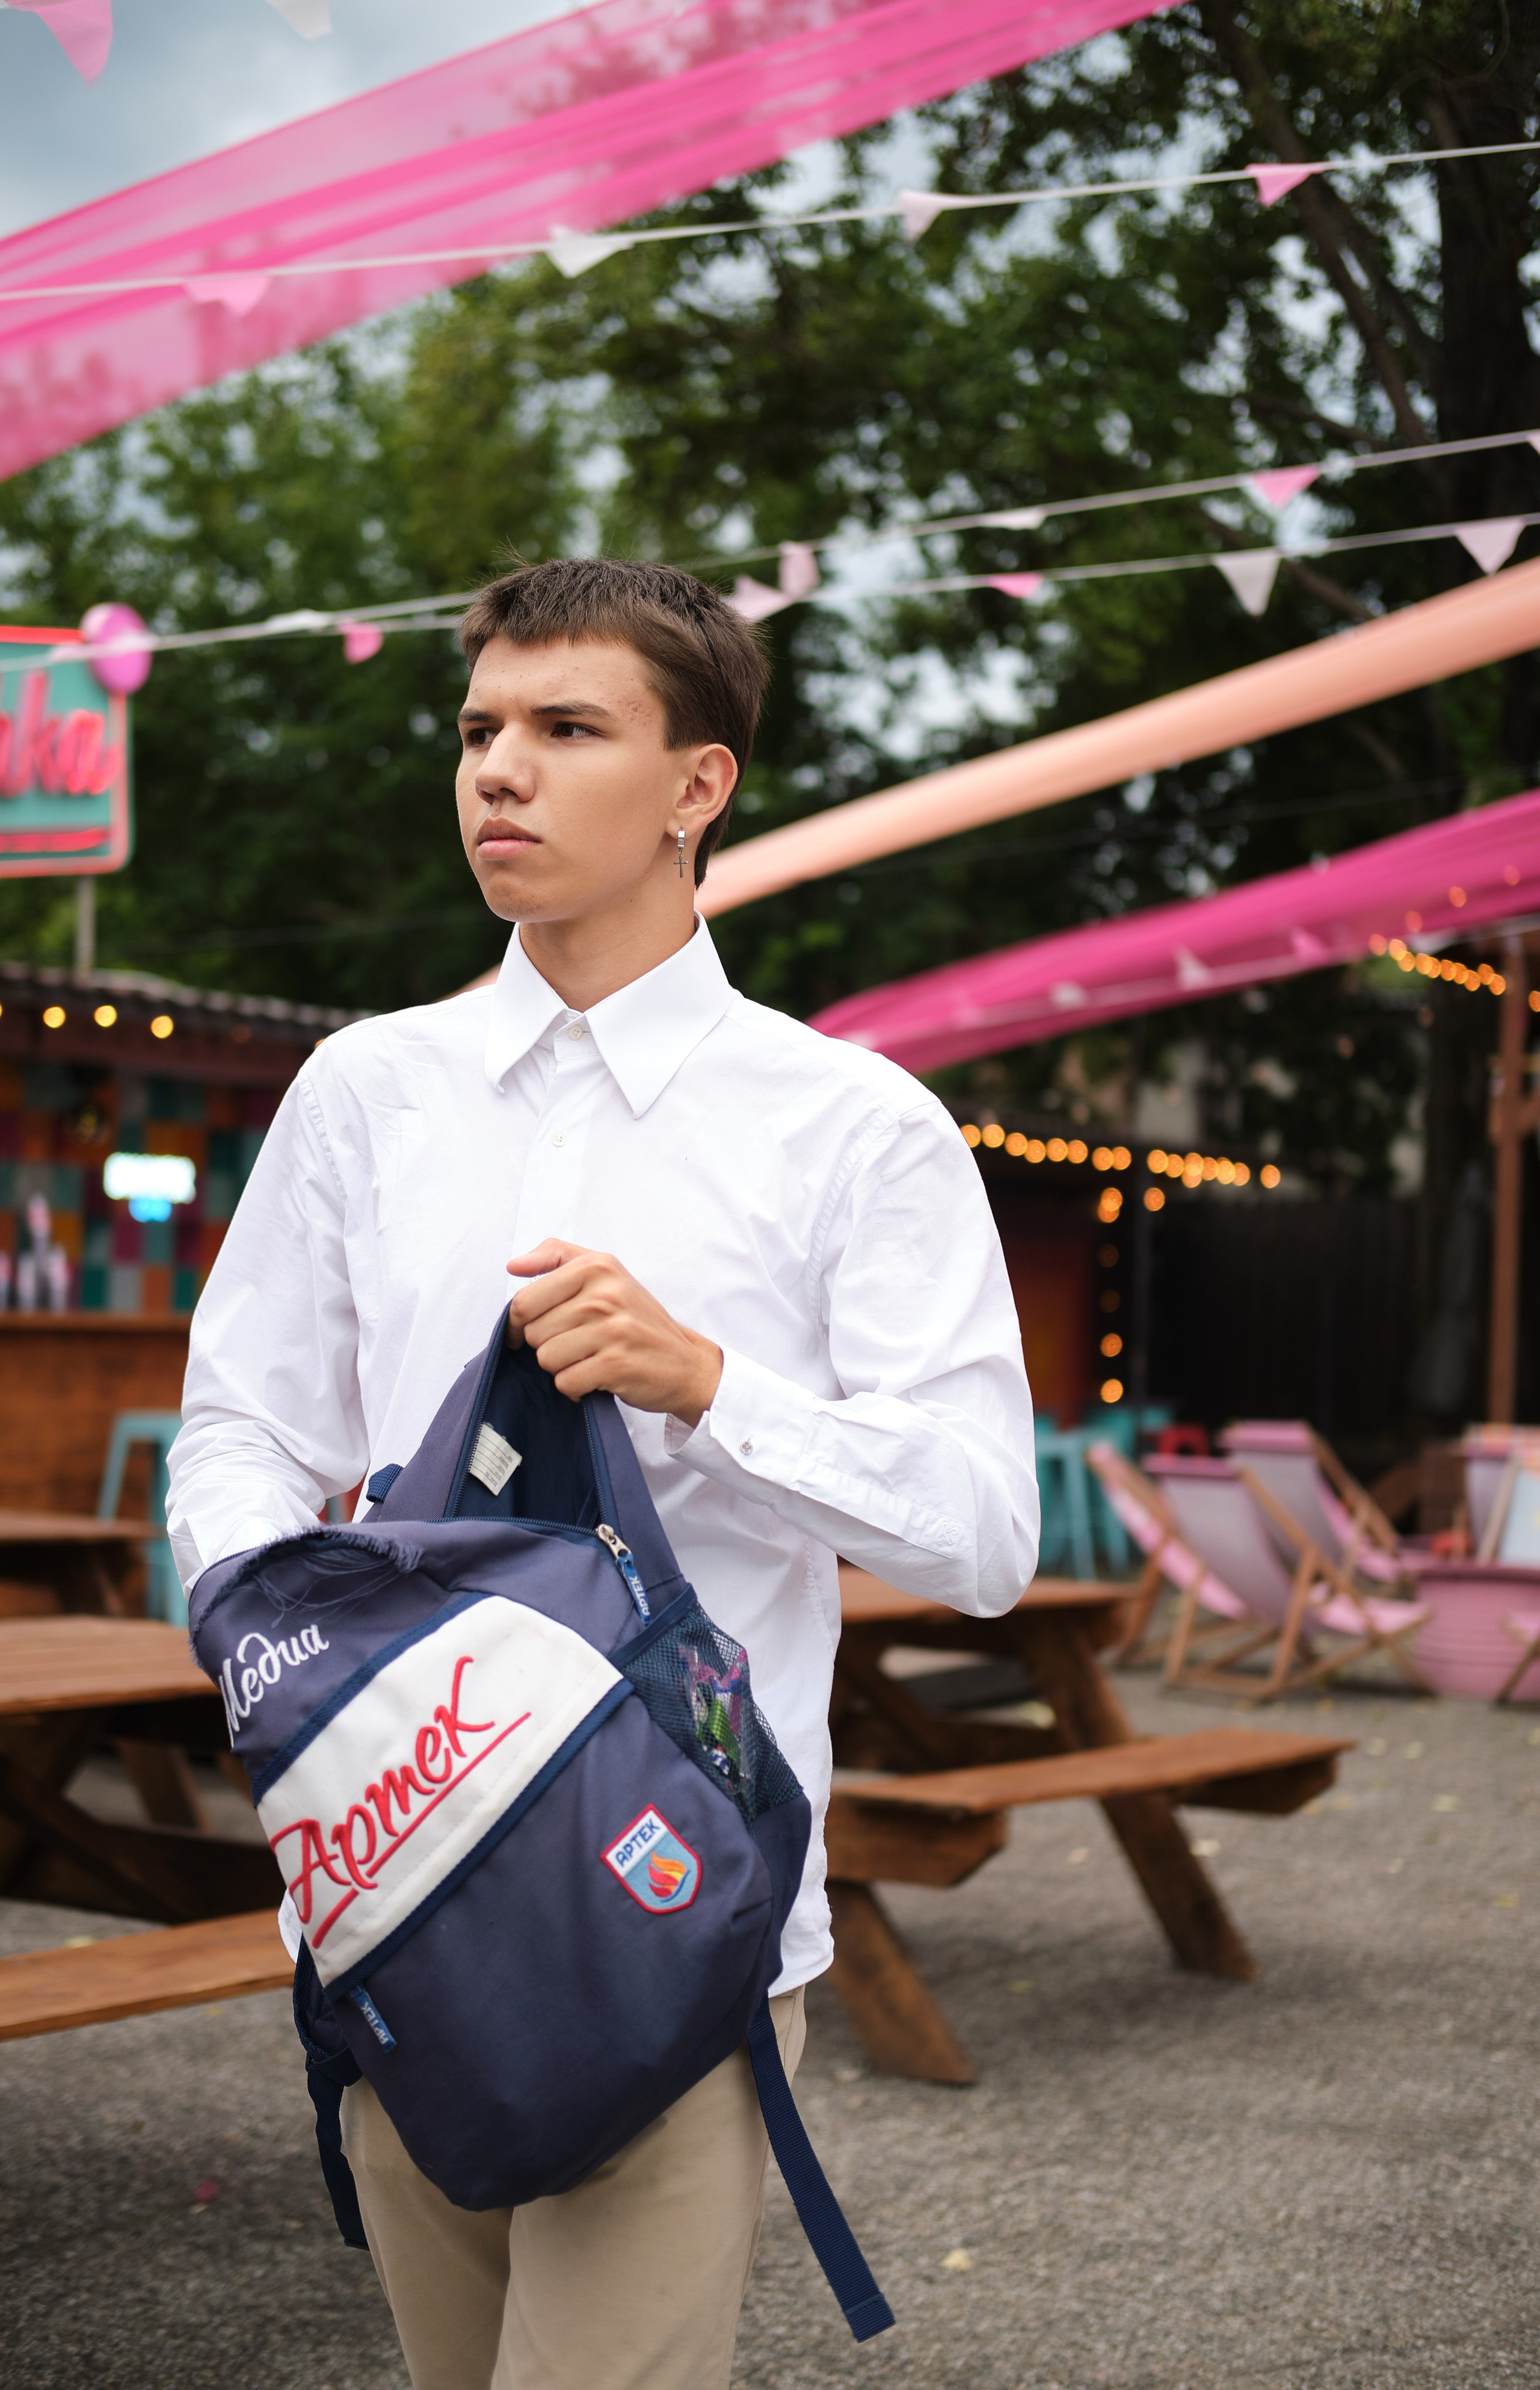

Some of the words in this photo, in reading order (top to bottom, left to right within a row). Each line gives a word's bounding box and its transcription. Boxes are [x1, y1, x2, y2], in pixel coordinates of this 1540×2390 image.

[629, 1575, 650, 1616] АРТЕК
[271, 1656, 495, 1924] Артек
[615, 1818, 661, 1867] АРТЕК
[361, 2002, 389, 2045] АРТЕК
